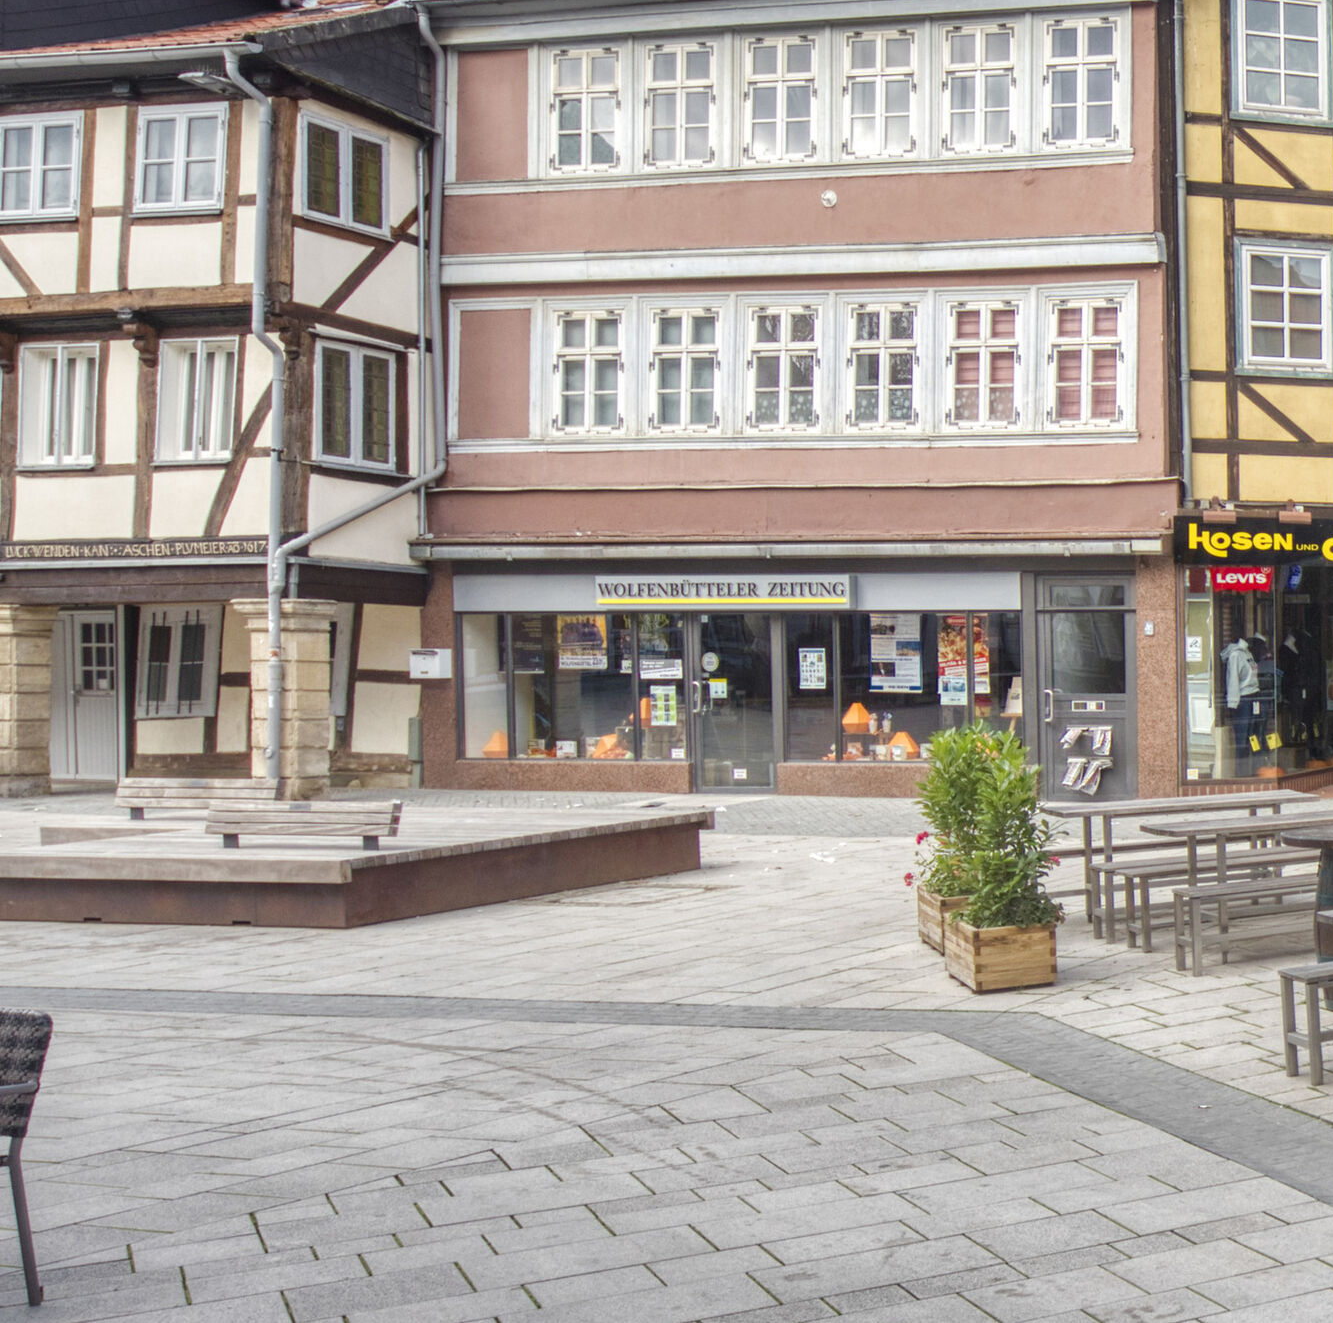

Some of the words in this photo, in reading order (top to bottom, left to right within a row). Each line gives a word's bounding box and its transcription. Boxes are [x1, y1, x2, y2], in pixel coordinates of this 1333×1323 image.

[1296, 543, 1319, 552] UND
[598, 579, 759, 598] WOLFENBÜTTELER
[767, 581, 845, 597] ZEITUNG
